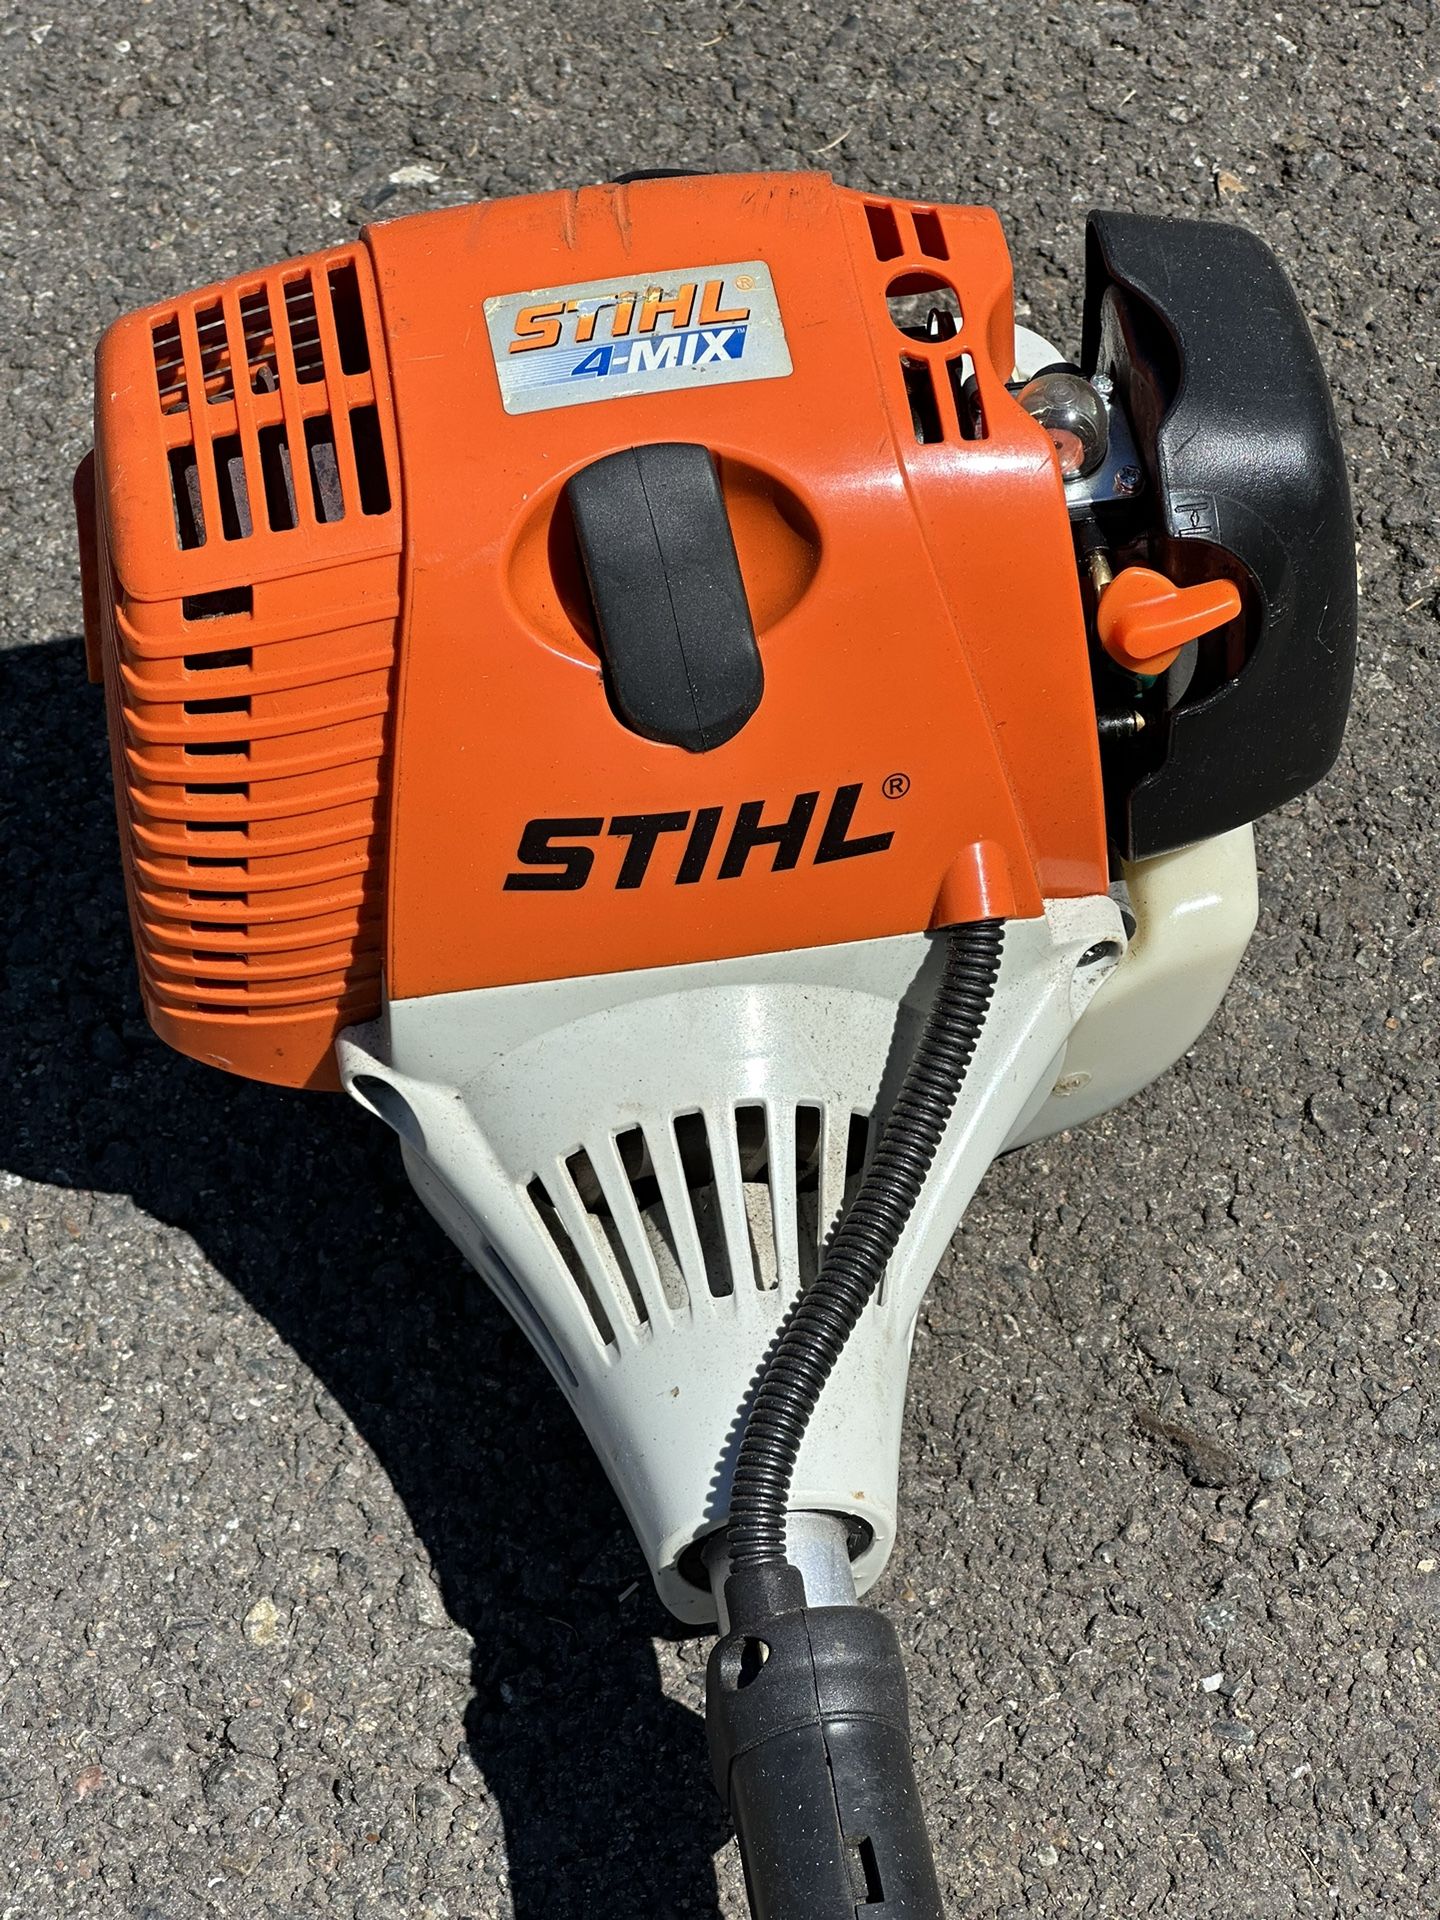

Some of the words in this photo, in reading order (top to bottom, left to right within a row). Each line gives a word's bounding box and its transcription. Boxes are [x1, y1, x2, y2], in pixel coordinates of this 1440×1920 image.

[508, 280, 751, 354] STIHL
[570, 329, 736, 378] 4-MIX
[502, 783, 896, 891] STIHL
